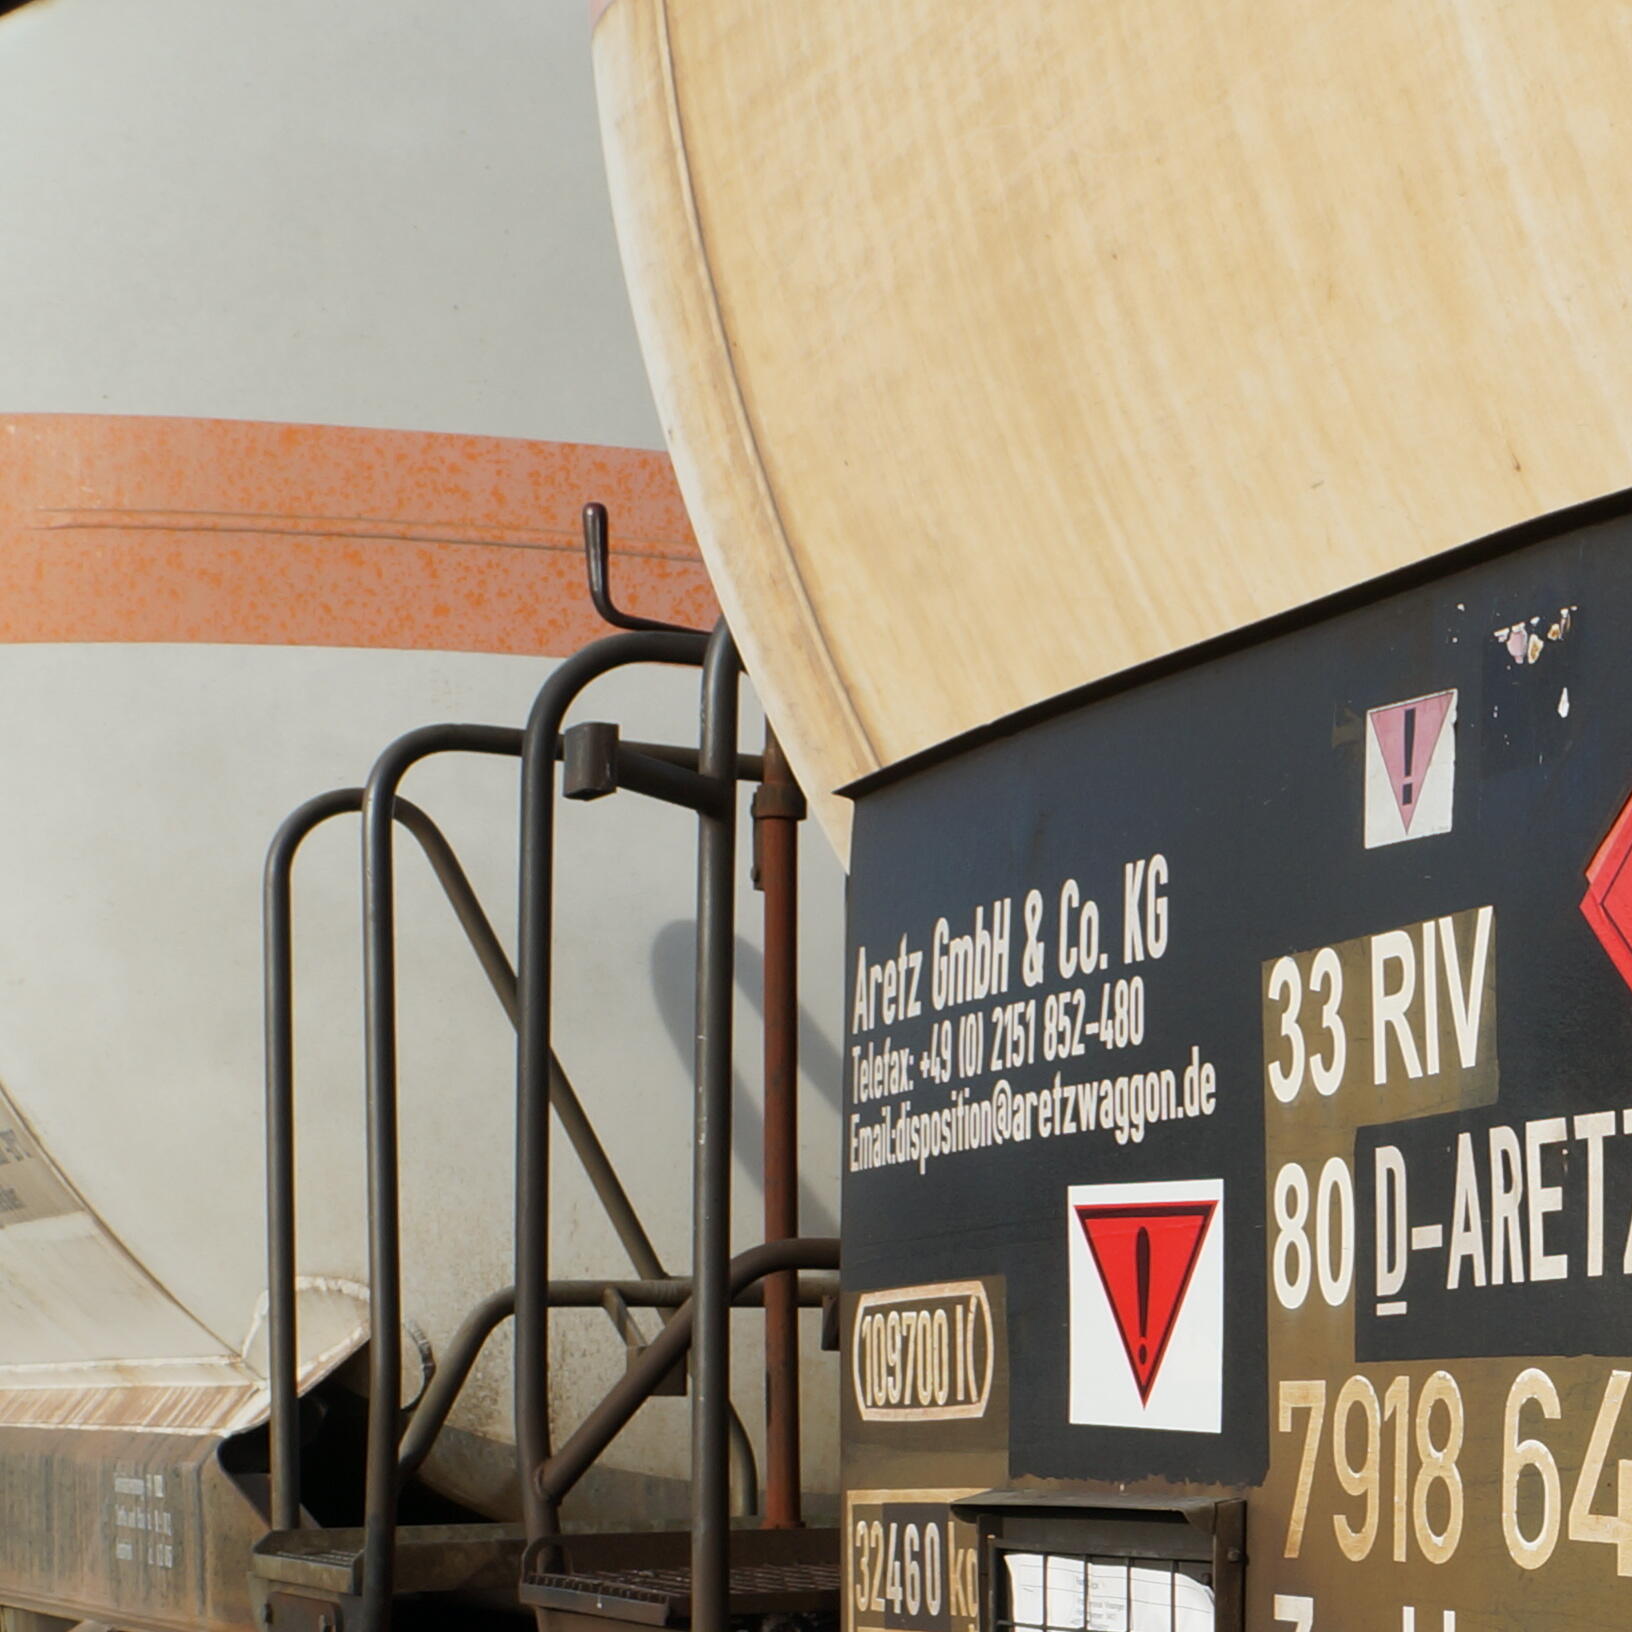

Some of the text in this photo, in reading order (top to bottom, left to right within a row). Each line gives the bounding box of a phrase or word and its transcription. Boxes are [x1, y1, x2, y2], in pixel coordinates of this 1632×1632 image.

[853, 853, 1169, 1034] Aretz GmbH & Co. KG
[1267, 905, 1494, 1103] 33 RIV
[852, 976, 1145, 1104] Telefax: +49 (0) 2151 852-480
[1273, 1156, 1355, 1310] 80
[861, 1308, 949, 1407] 109700
[1278, 1369, 1465, 1565] 7918
